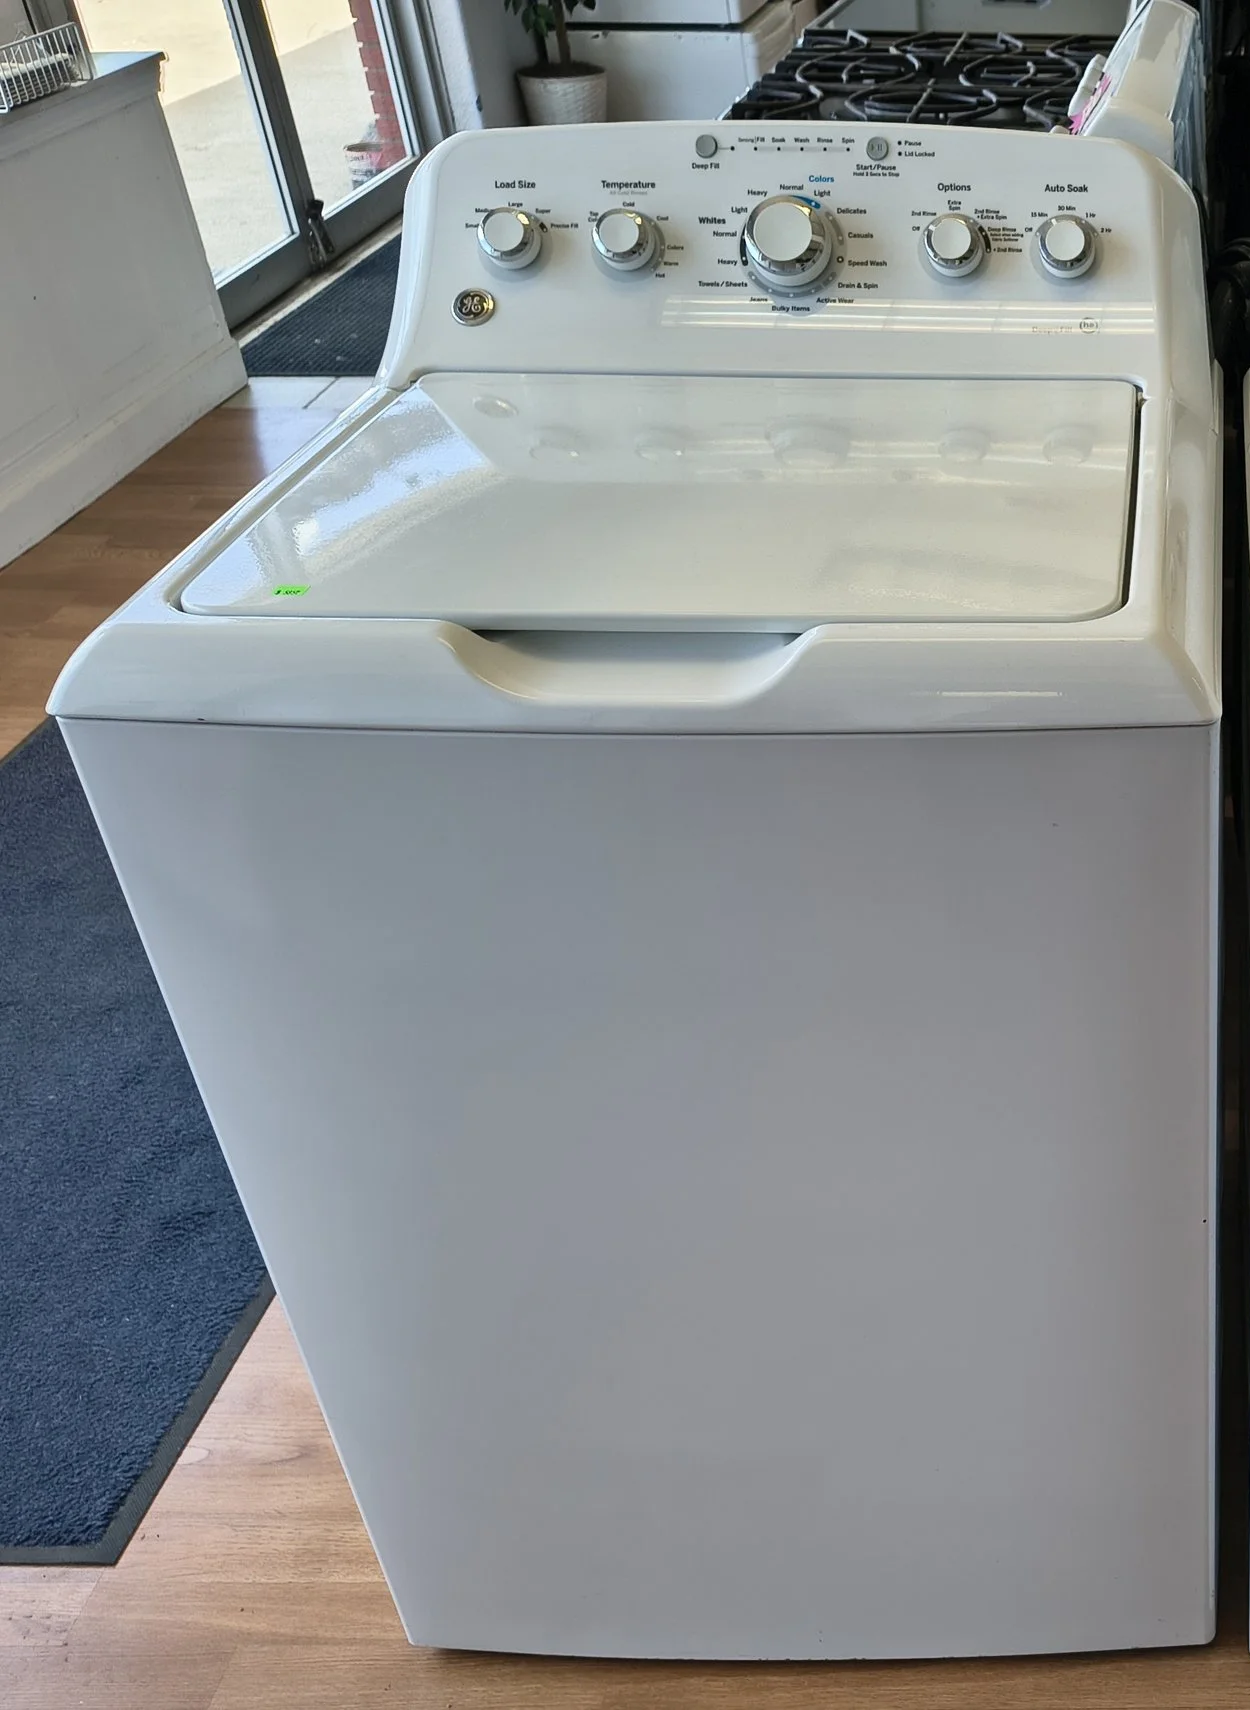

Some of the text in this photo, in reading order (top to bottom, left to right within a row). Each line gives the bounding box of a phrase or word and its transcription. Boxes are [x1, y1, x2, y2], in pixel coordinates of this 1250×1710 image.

[809, 175, 835, 183] Colors
[494, 180, 536, 189] Load Size
[601, 180, 656, 190] Temperature
[937, 183, 972, 193] Options
[1044, 184, 1089, 193] Auto Soak
[747, 189, 768, 197] Heavy
[814, 189, 831, 197] Light
[731, 206, 748, 214] Light
[698, 217, 726, 225] Whites
[717, 258, 738, 266] Heavy
